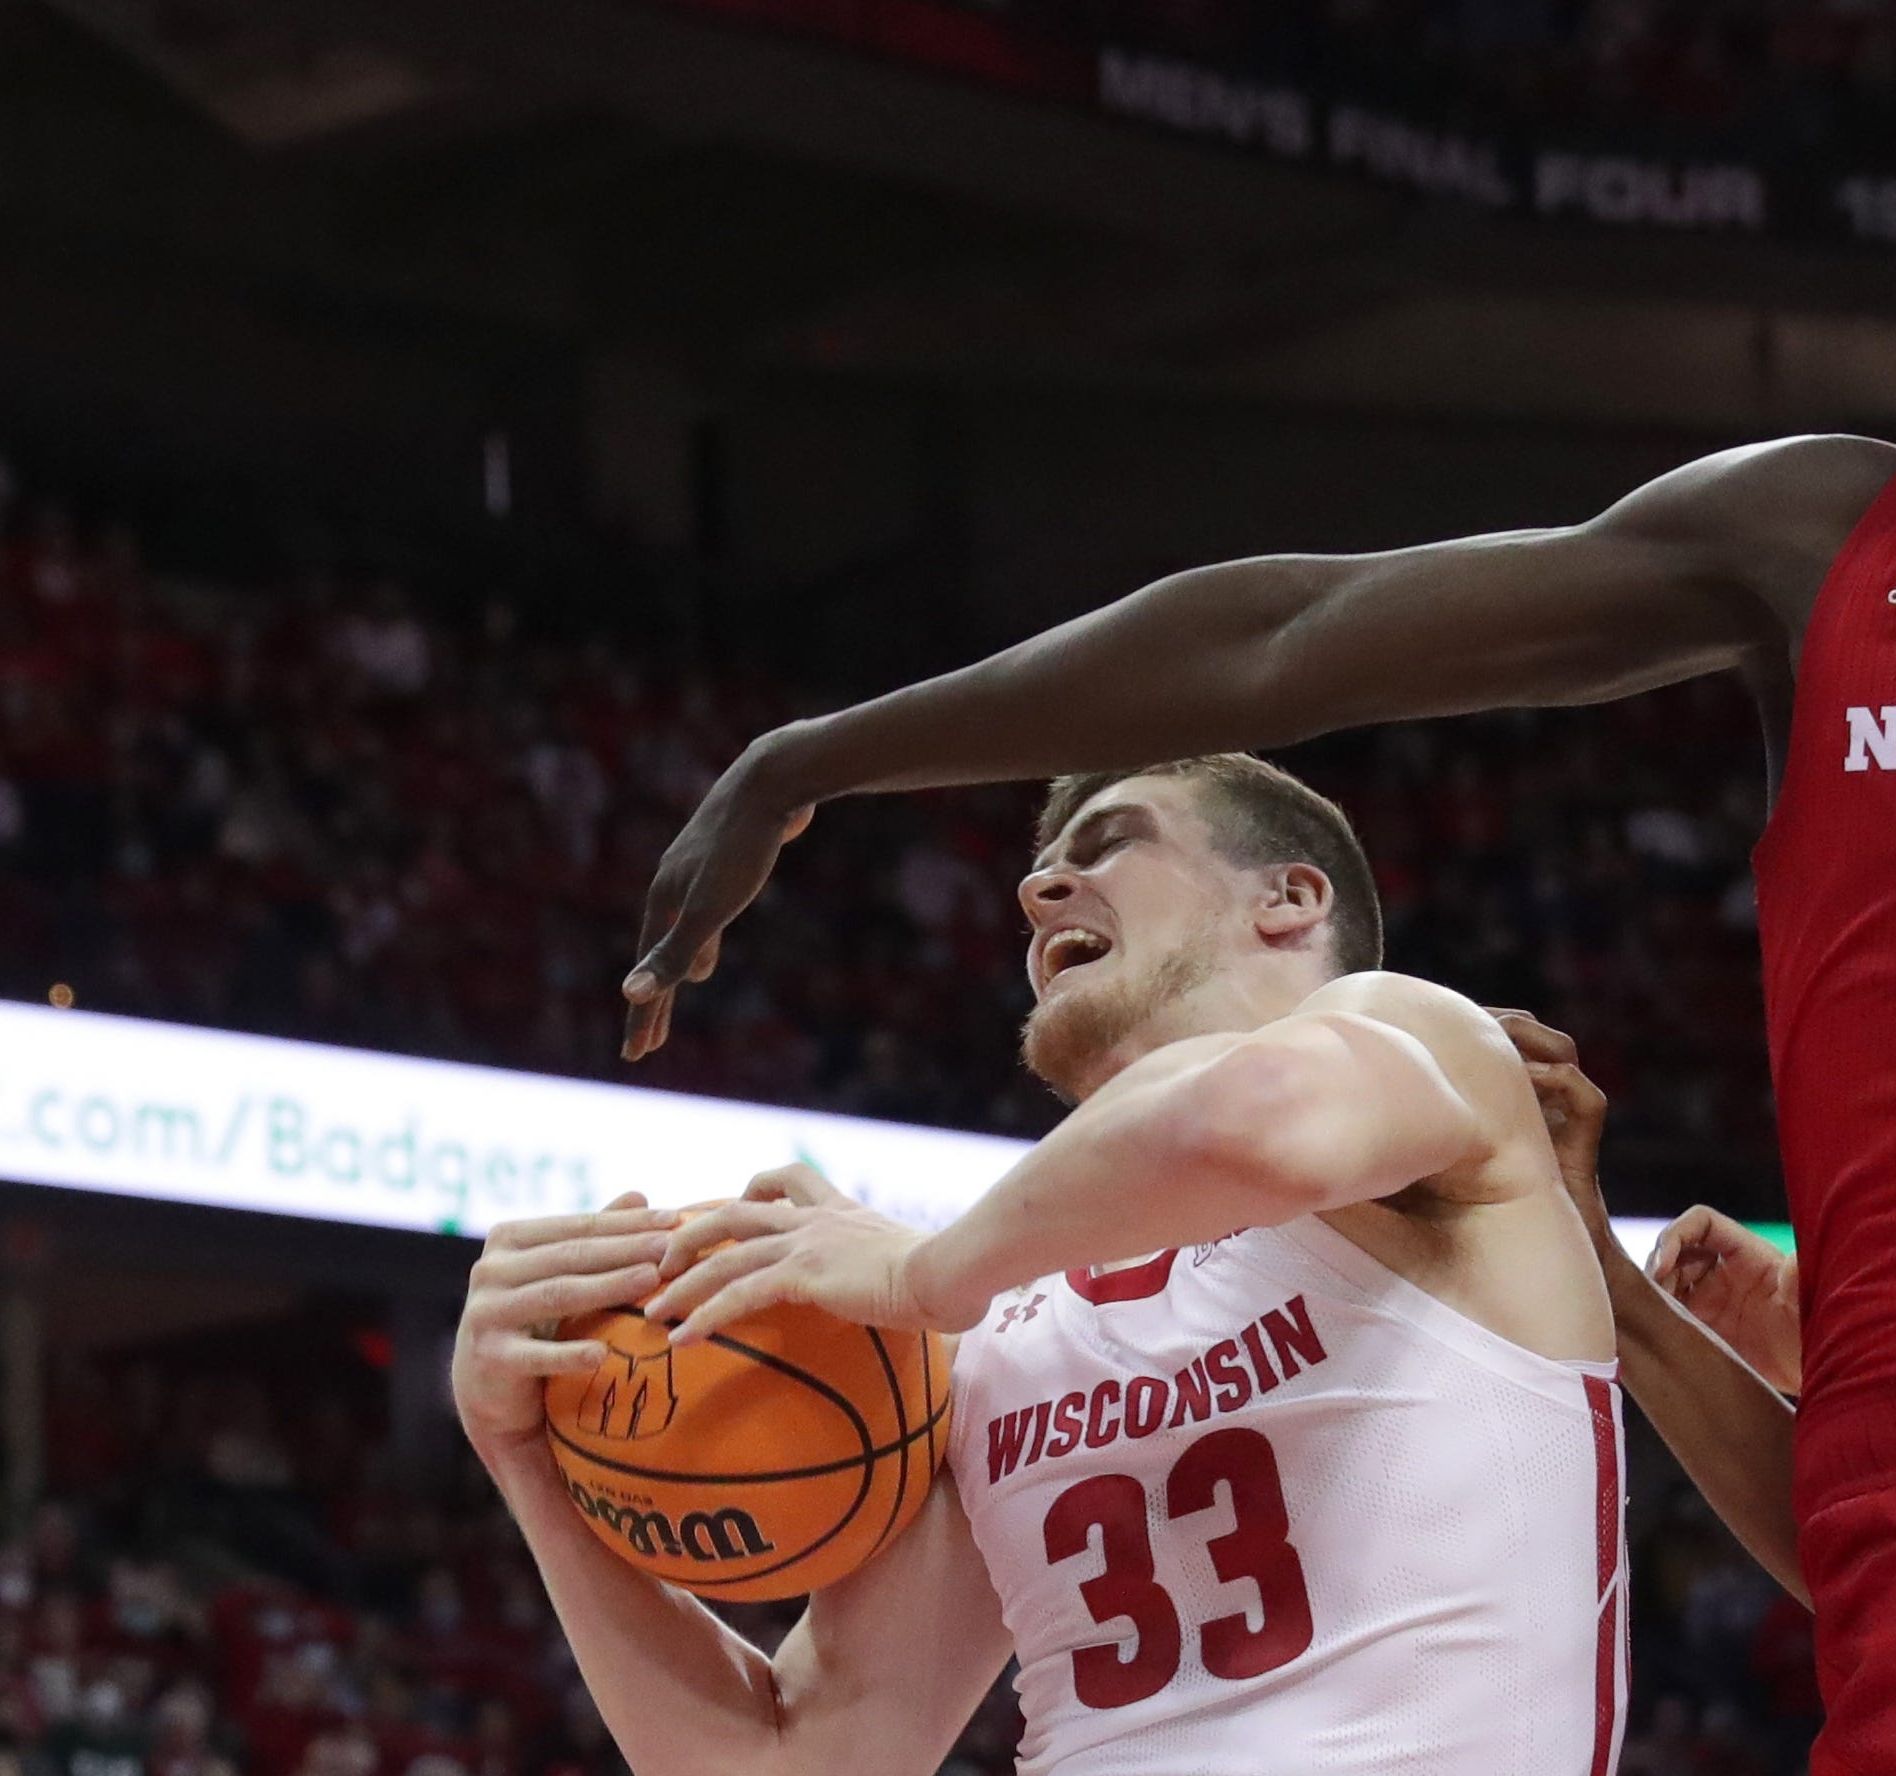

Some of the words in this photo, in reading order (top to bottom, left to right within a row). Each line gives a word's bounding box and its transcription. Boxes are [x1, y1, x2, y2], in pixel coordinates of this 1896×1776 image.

[1532, 152, 1764, 226] FOUR
[987, 1294, 1328, 1486] WISCONSIN
[1043, 1426, 1315, 1710] 33
